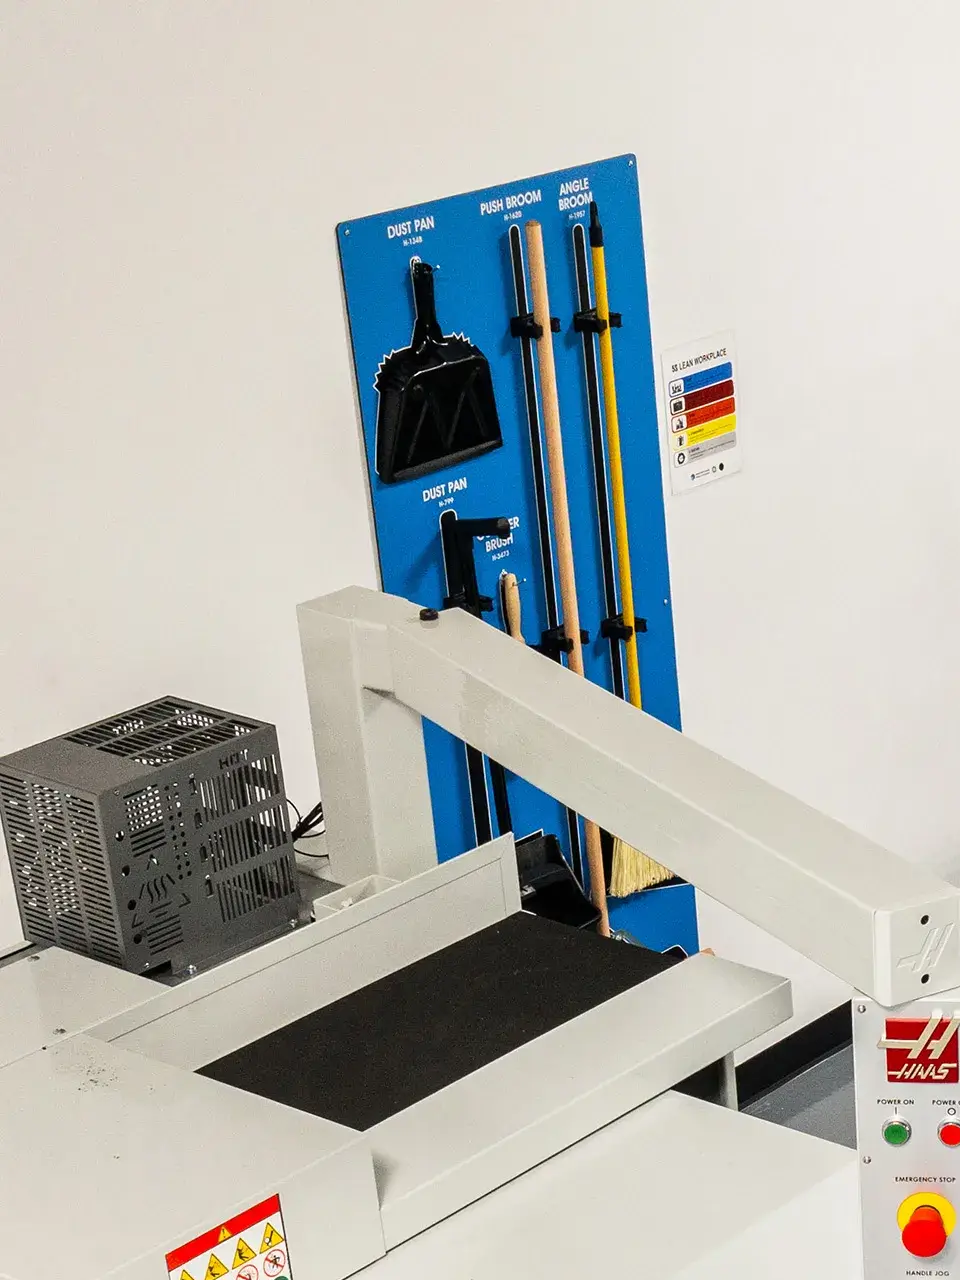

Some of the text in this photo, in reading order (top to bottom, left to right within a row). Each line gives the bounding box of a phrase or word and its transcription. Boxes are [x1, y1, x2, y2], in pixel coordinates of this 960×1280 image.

[559, 177, 590, 197] ANGLE
[480, 189, 542, 216] PUSH BROOM
[558, 192, 593, 212] BROOM
[387, 215, 435, 239] DUST PAN
[679, 357, 694, 371] LEAN
[694, 347, 728, 366] WORKPLACE
[422, 477, 468, 502] DUST PAN
[485, 533, 514, 553] BRUSH
[888, 1063, 957, 1080] HAAS
